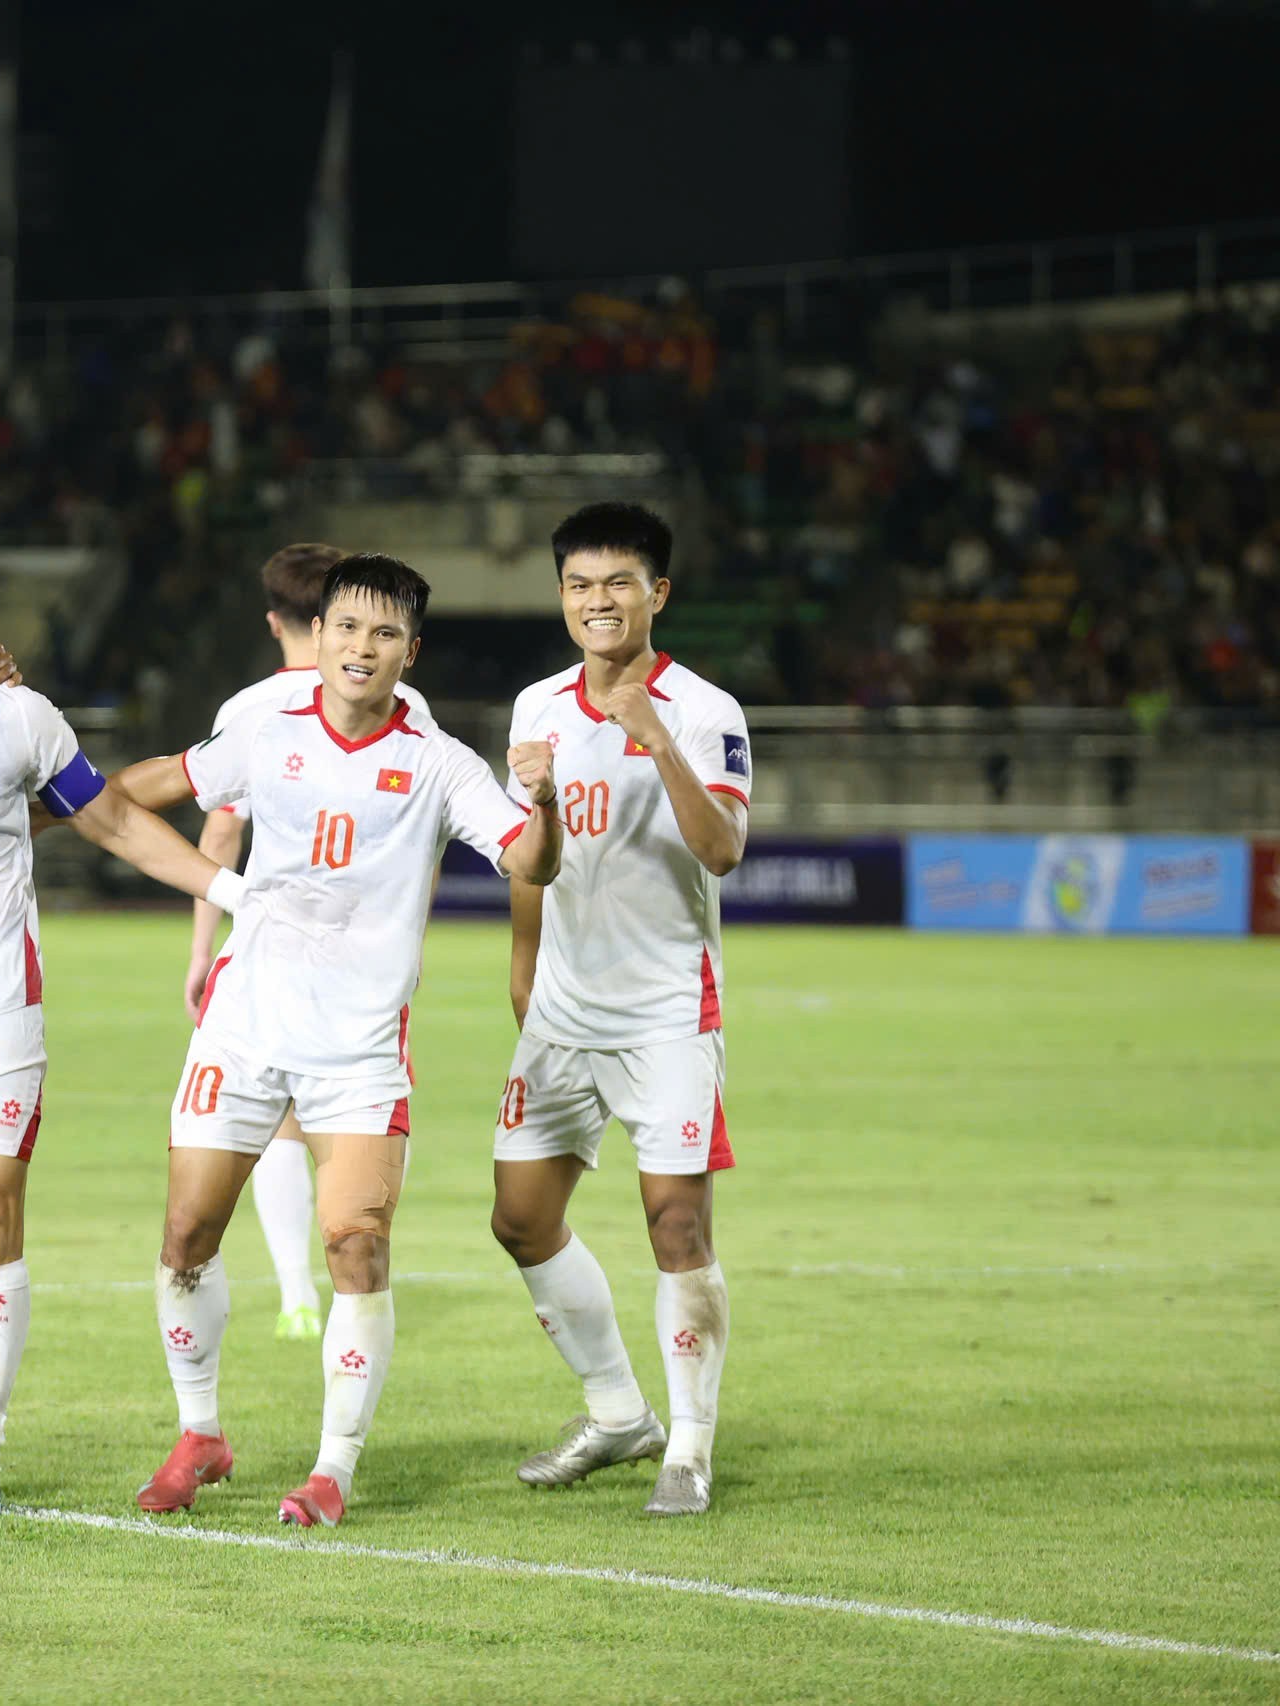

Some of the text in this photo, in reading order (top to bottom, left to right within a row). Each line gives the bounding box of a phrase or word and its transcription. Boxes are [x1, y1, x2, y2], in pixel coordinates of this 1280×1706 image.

[565, 779, 610, 838] 20
[311, 809, 355, 870] 10
[181, 1062, 225, 1116] 10
